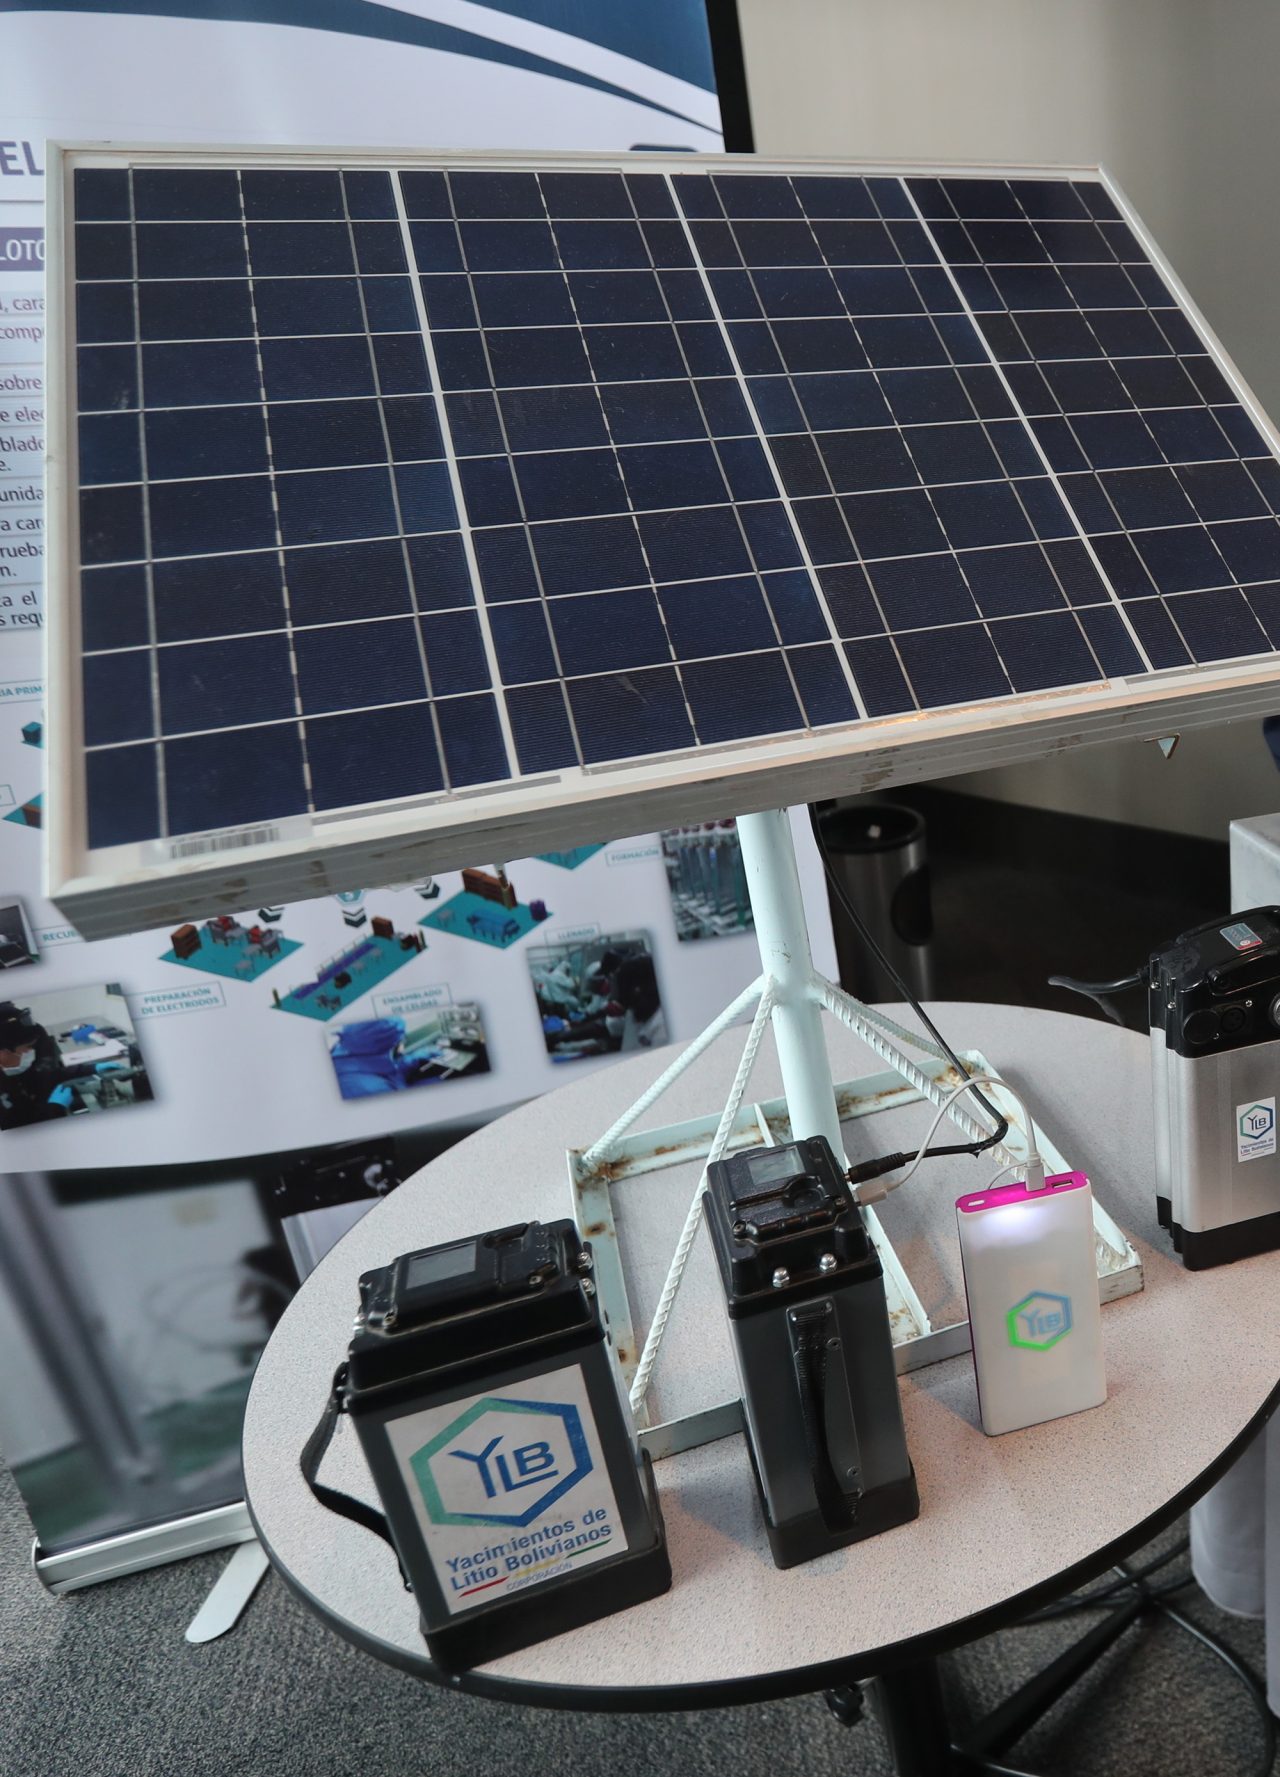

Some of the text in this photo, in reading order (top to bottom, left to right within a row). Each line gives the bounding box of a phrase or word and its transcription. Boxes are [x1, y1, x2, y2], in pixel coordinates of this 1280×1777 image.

[0, 327, 44, 342] comp
[15, 519, 45, 531] car
[22, 590, 37, 605] el
[43, 930, 78, 942] RECU
[144, 987, 210, 1003] PREPARACIÓN
[142, 996, 219, 1015] DE ELECTRODOS
[1247, 1114, 1267, 1131] YLB
[1020, 1309, 1060, 1338] YLB
[448, 1435, 559, 1499] YLB
[446, 1507, 607, 1573] Yacimientos de
[451, 1524, 612, 1591] Litio Bolivianos
